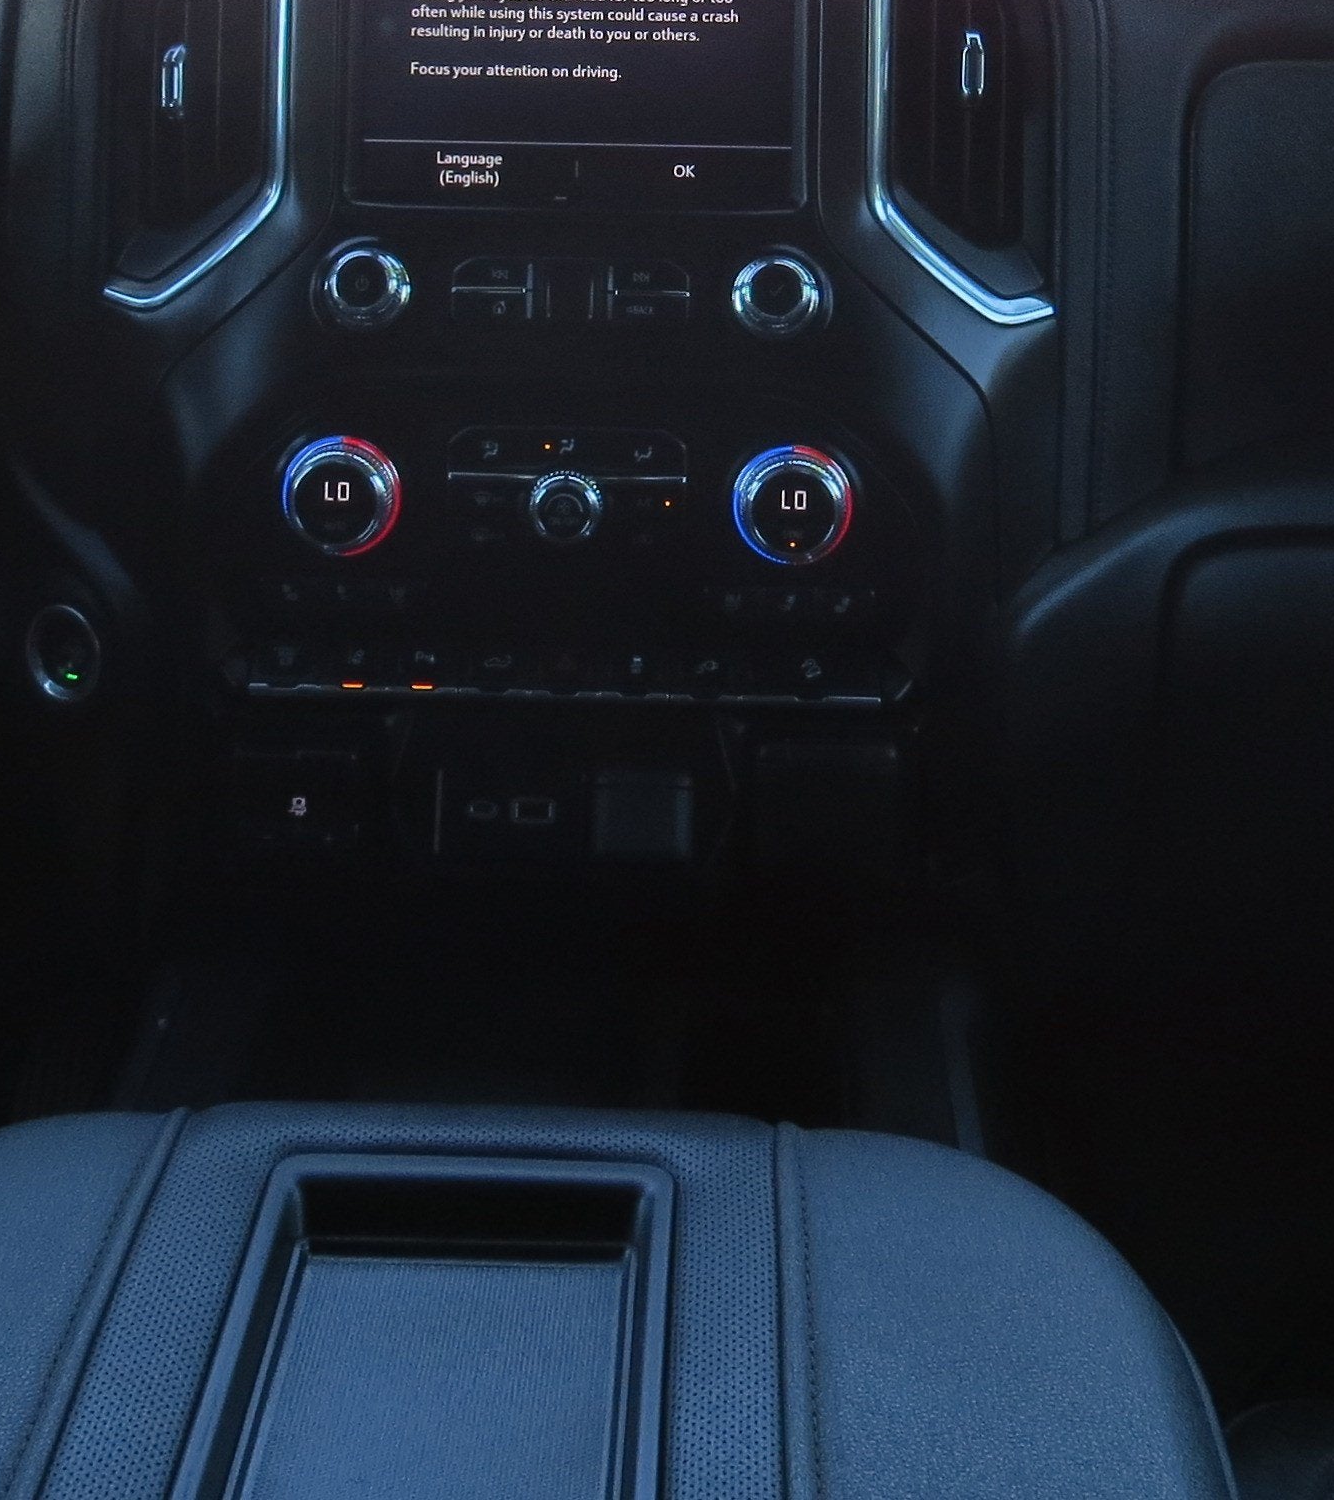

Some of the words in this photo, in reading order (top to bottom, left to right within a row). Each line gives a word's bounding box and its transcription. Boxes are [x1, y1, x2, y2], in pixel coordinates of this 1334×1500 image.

[411, 4, 447, 19] often
[450, 5, 486, 20] while
[488, 7, 526, 23] using
[528, 6, 553, 21] this
[556, 9, 604, 25] system
[607, 8, 645, 22] could
[647, 12, 687, 24] cause
[689, 13, 699, 24] a
[701, 9, 739, 24] crash
[410, 23, 469, 41] resulting
[473, 25, 486, 38] in
[488, 25, 526, 42] injury
[528, 29, 543, 40] or
[546, 25, 586, 41] death
[589, 27, 604, 41] to
[605, 30, 631, 45] you
[634, 30, 649, 41] or
[652, 26, 700, 43] others.
[410, 61, 451, 77] Focus
[452, 65, 483, 80] your
[486, 64, 548, 78] attention
[551, 67, 569, 79] on
[572, 64, 622, 82] driving.
[436, 151, 503, 169] Language
[439, 170, 500, 188] (English)
[673, 164, 696, 179] OK
[322, 480, 351, 503] LO
[780, 488, 809, 512] LO
